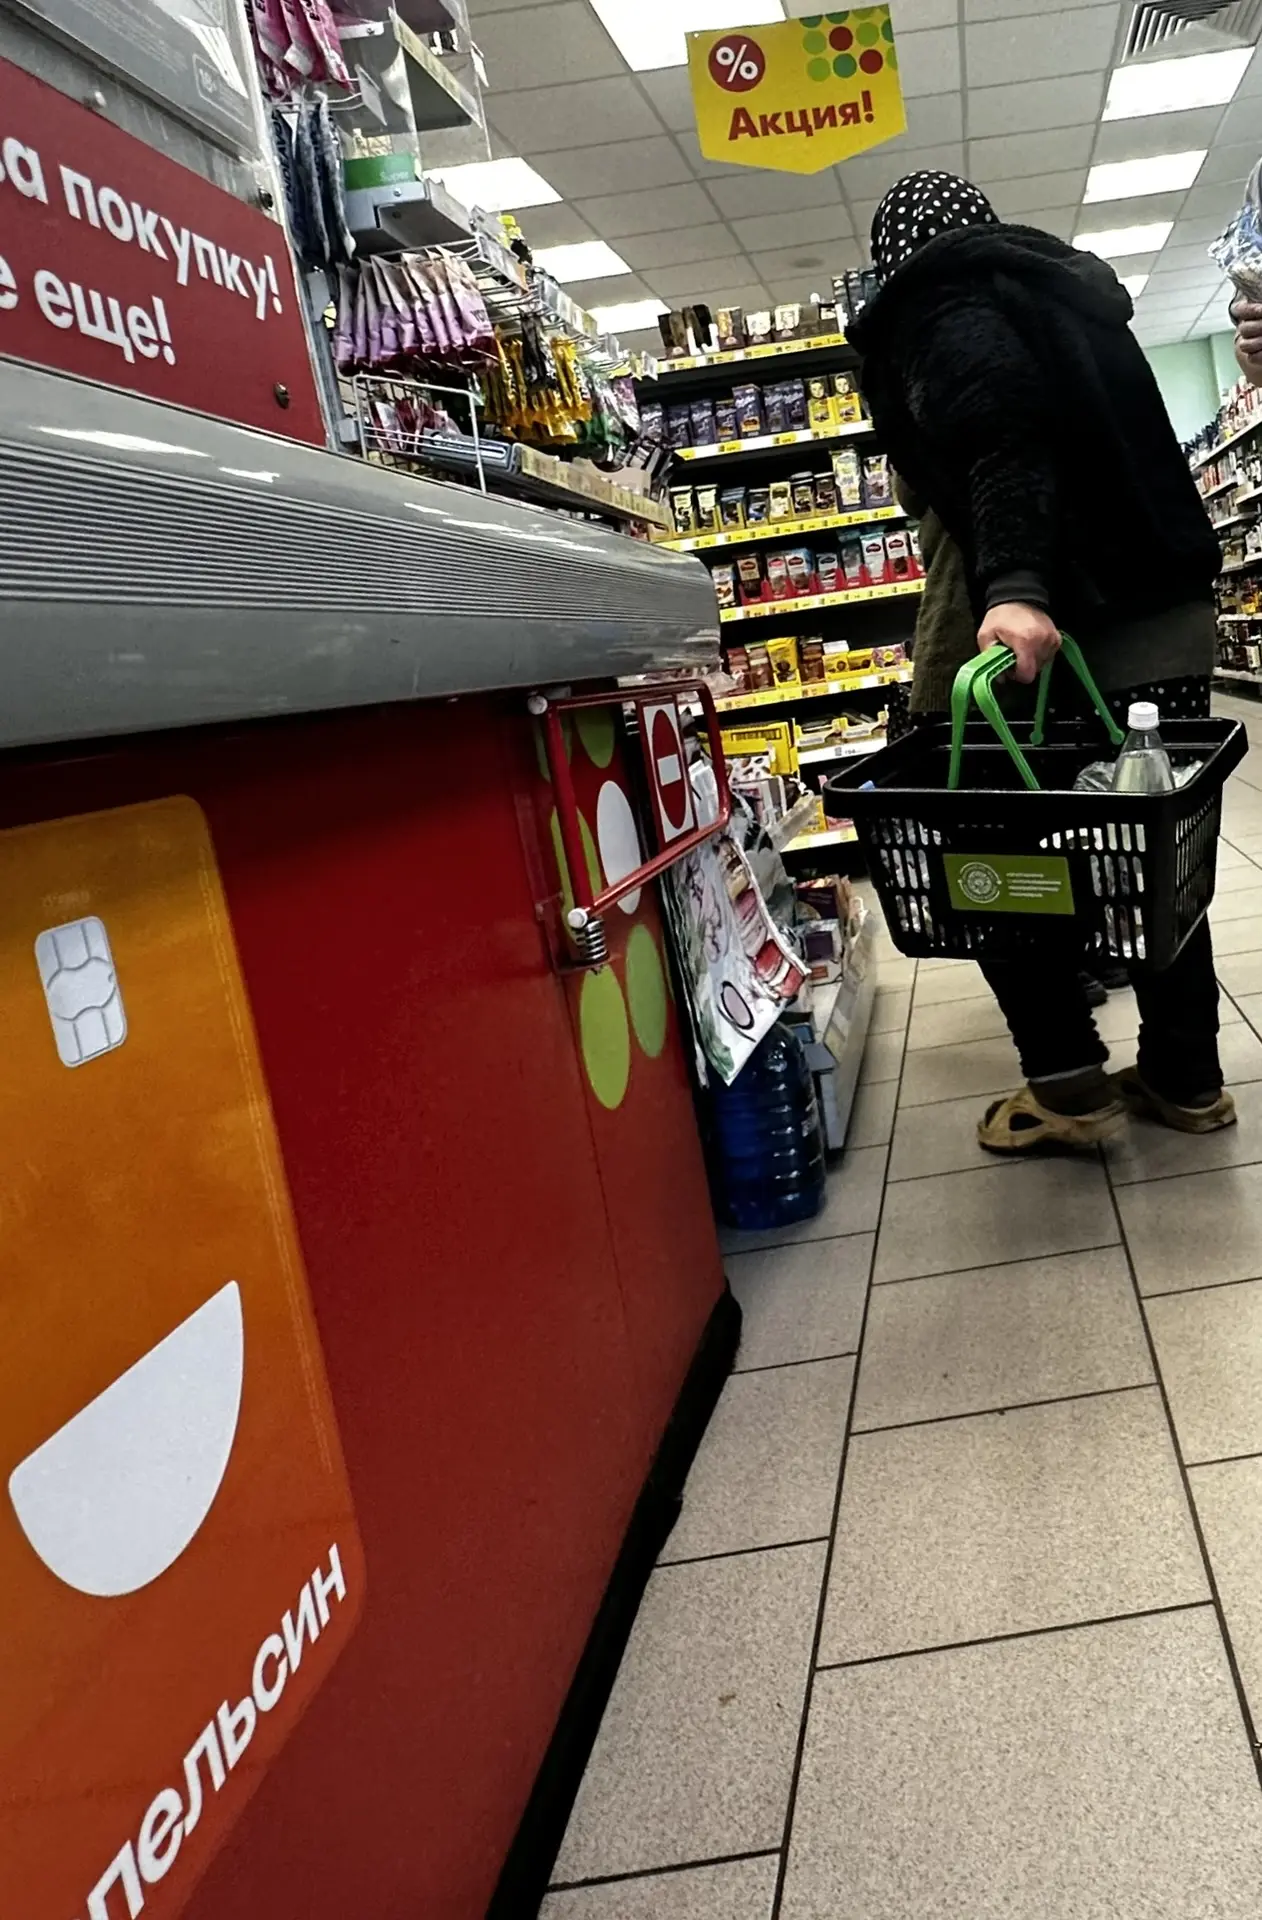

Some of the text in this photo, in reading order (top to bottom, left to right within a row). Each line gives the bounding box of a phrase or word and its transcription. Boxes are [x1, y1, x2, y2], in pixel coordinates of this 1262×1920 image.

[728, 90, 875, 141] Акция!
[0, 137, 283, 321] а покупку!
[34, 269, 176, 366] еще!
[73, 1542, 347, 1920] пельсин
